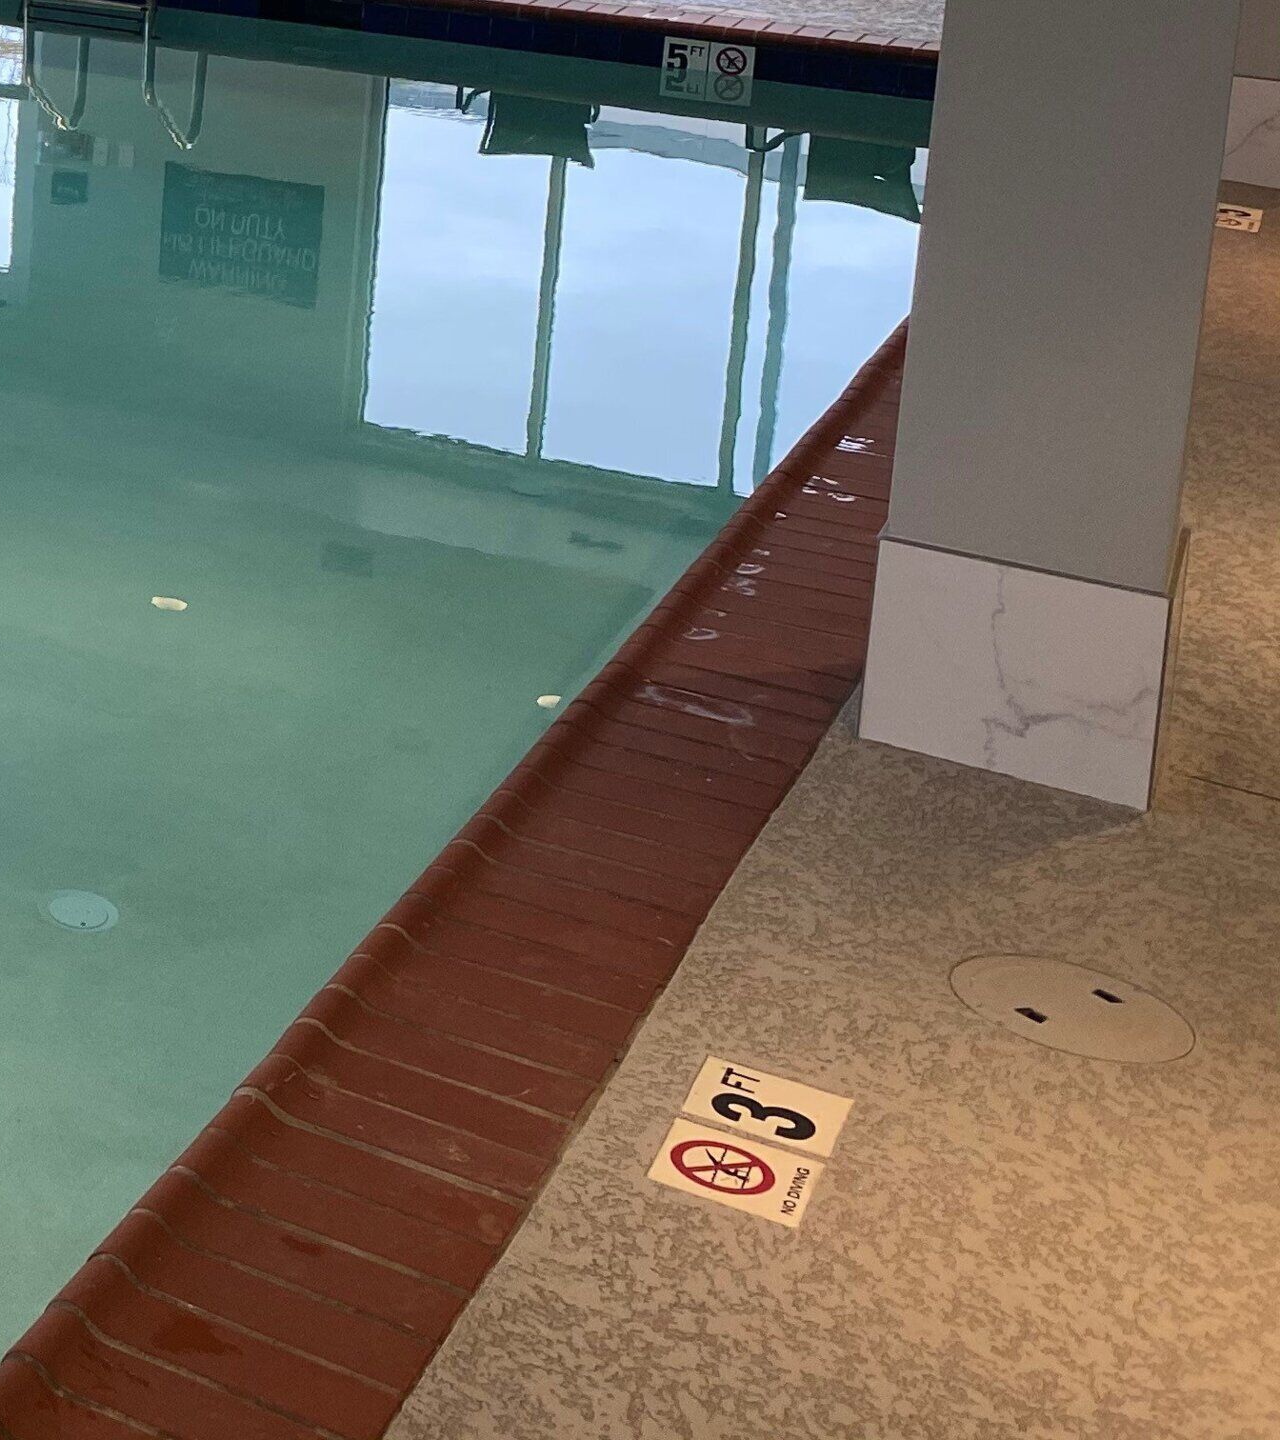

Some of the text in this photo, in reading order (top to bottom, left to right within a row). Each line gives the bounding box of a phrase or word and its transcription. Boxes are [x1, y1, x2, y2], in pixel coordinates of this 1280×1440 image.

[666, 43, 705, 71] 5 FT
[711, 1067, 816, 1140] 3 FT
[780, 1167, 810, 1216] NO DIVING
